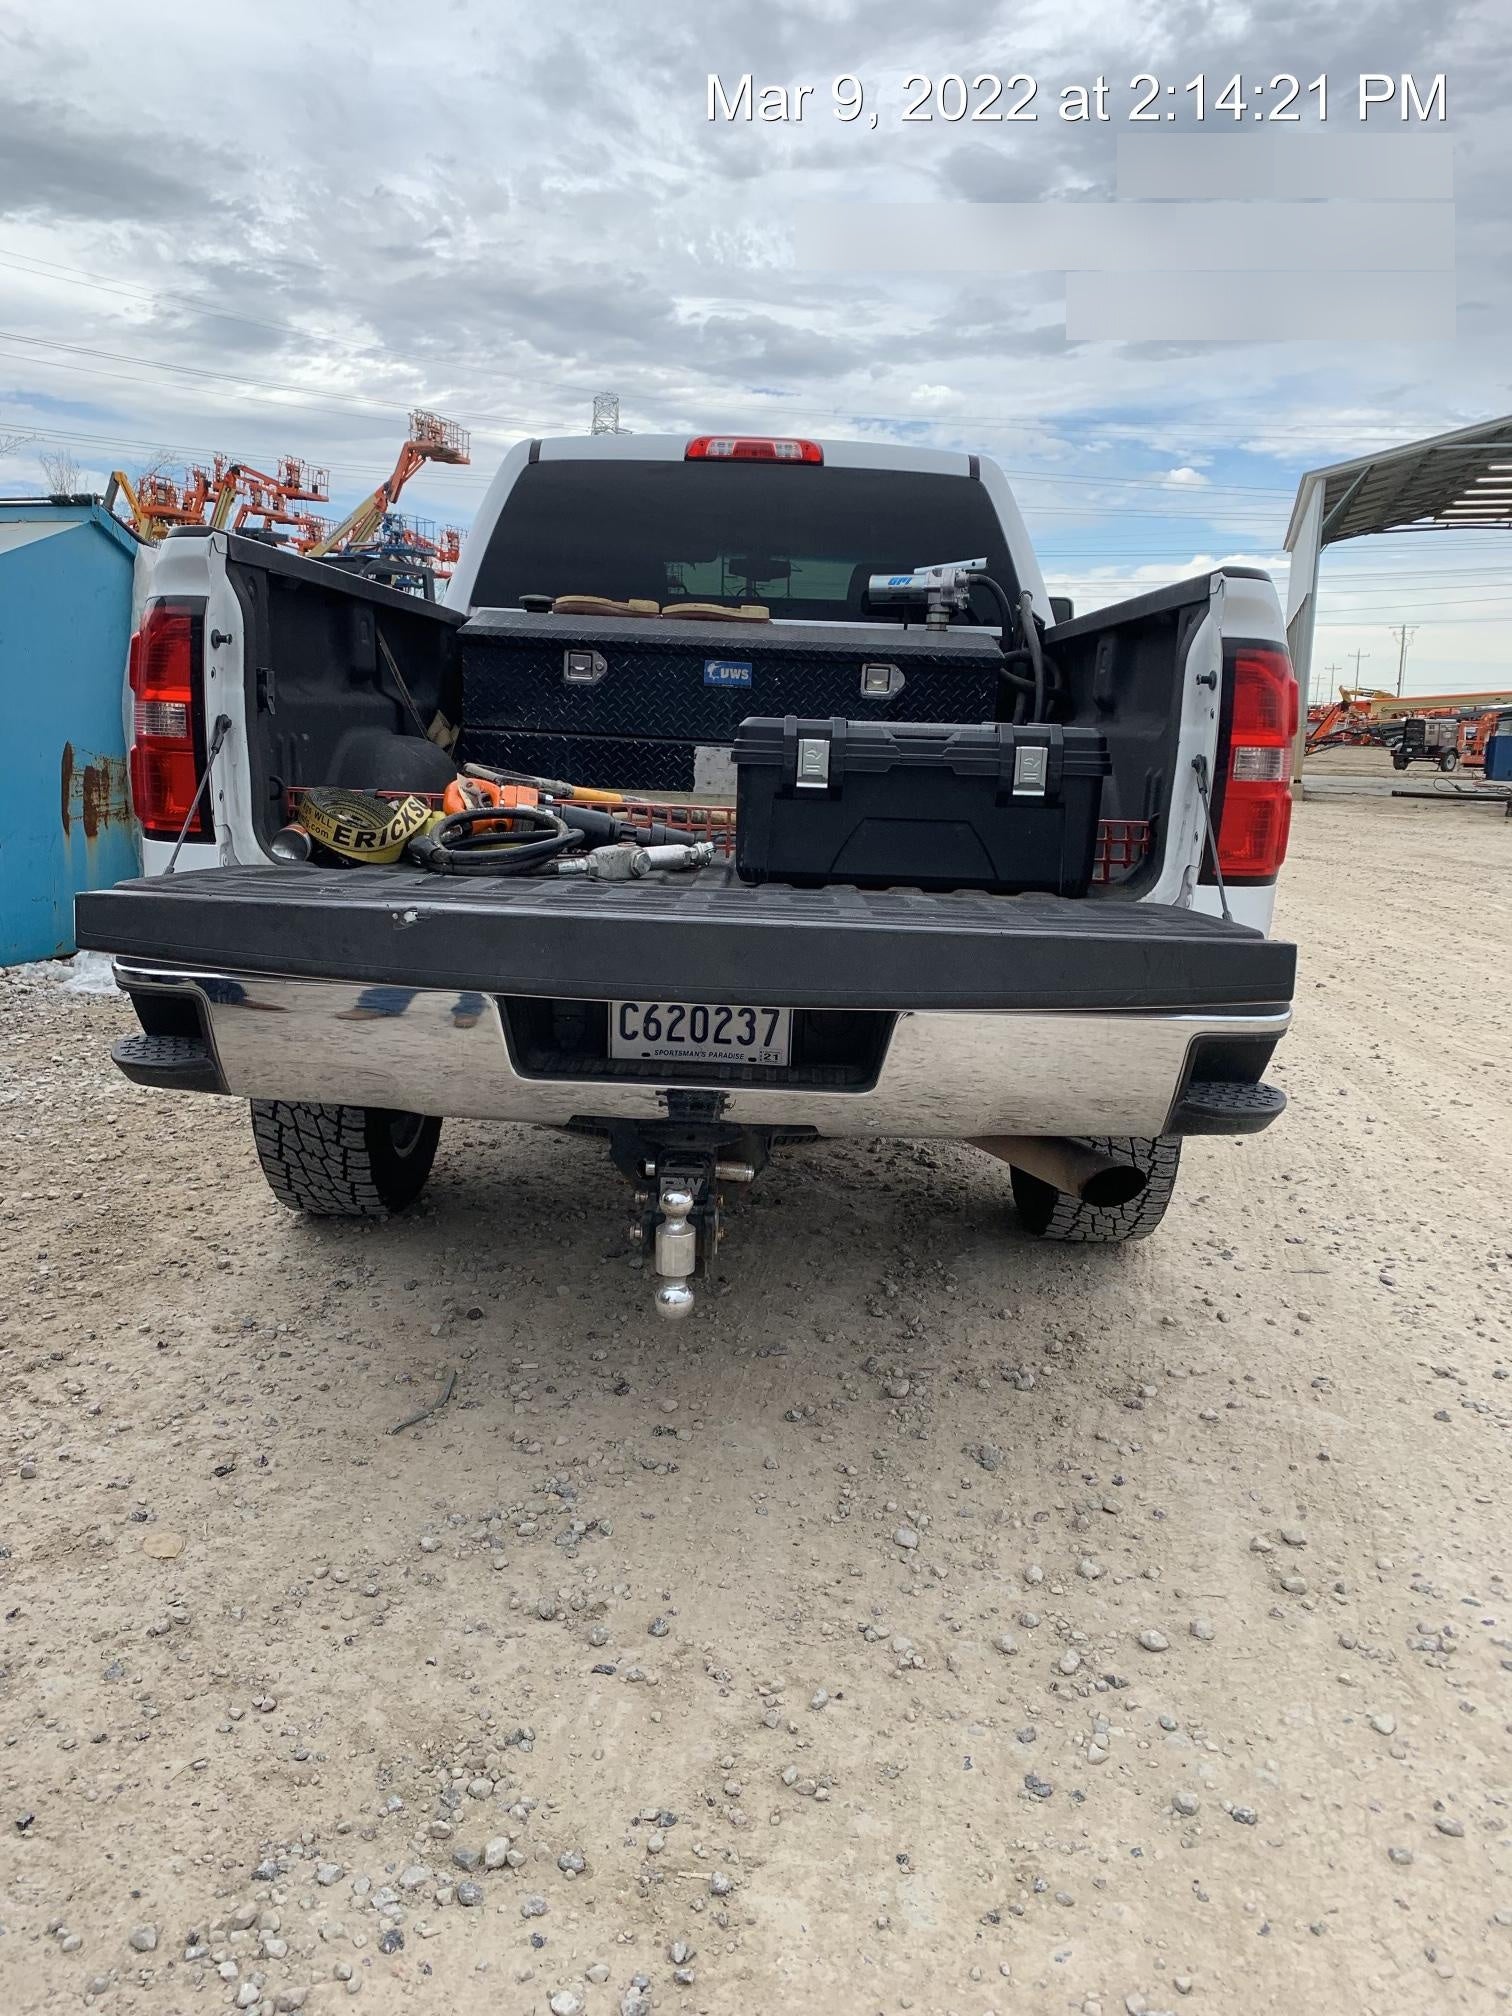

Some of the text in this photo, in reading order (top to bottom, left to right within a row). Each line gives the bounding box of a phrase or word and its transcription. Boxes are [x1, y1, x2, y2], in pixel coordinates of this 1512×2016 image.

[720, 667, 749, 680] UWS
[315, 811, 332, 829] WLL
[619, 1002, 780, 1047] C620237
[654, 1049, 779, 1061] SPORTSMAN'S PARADISE 21
